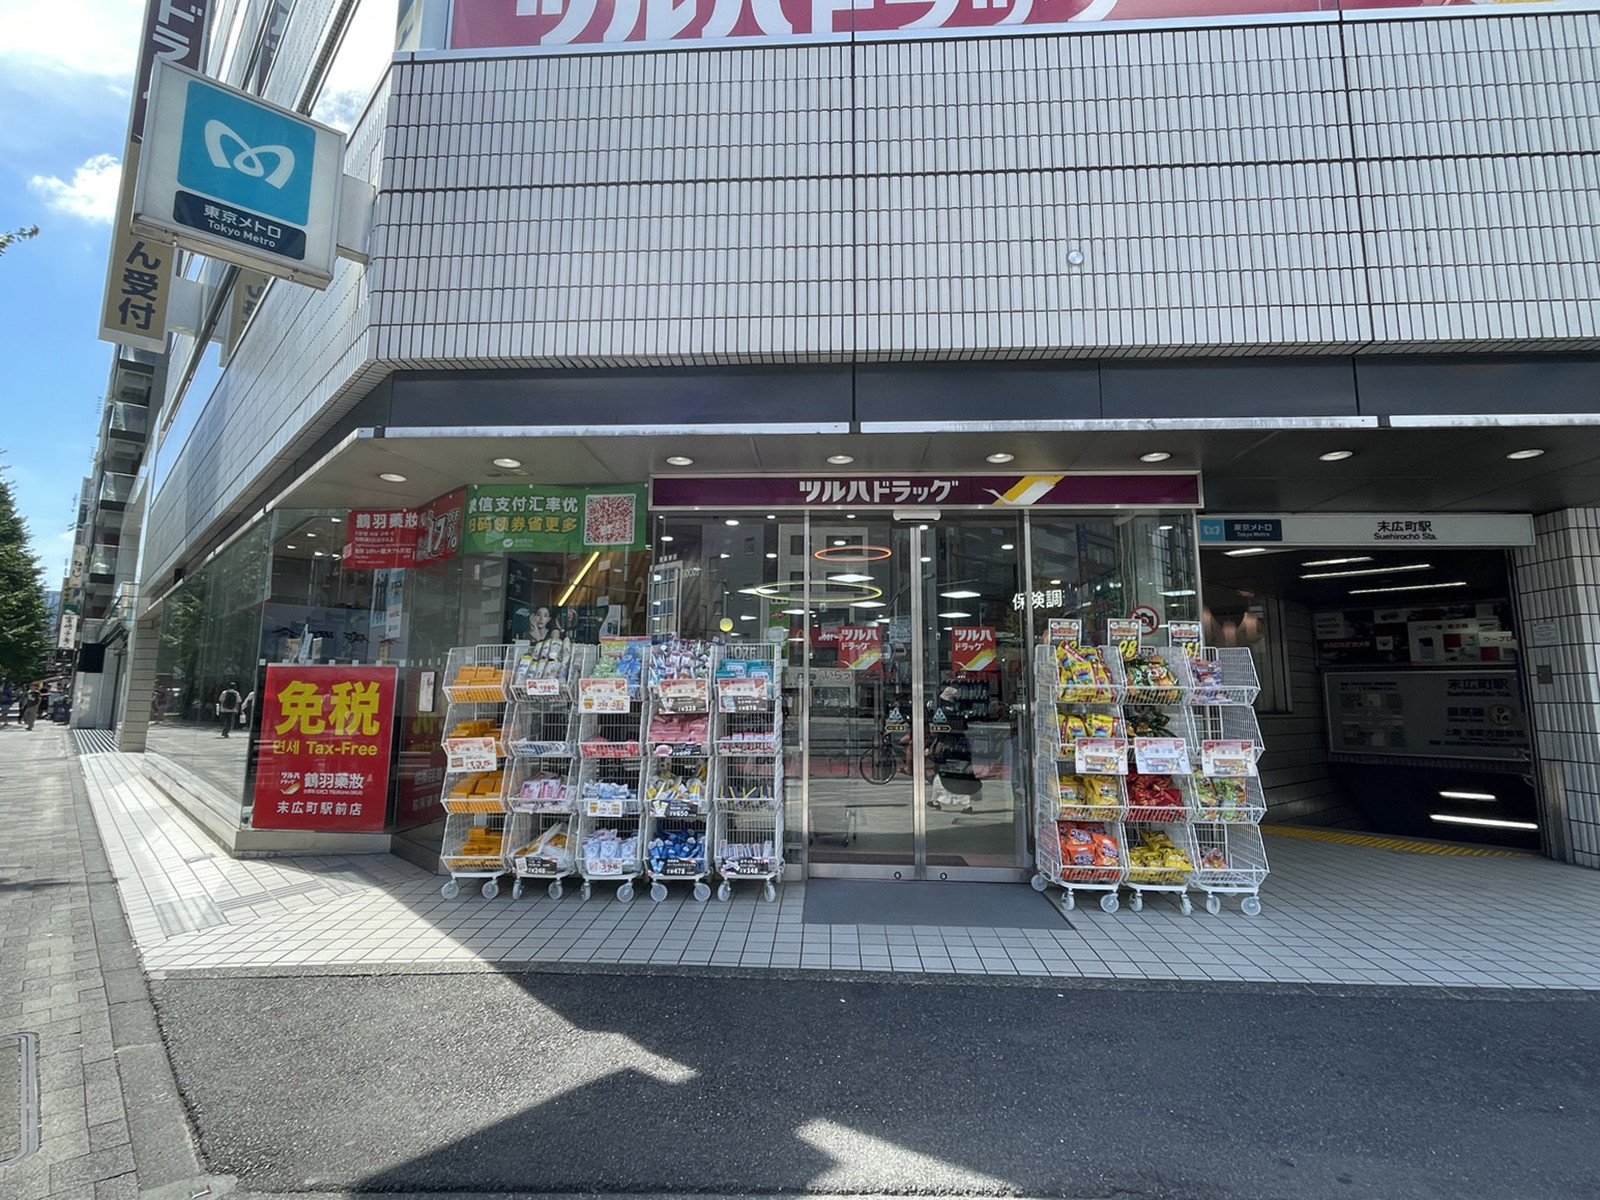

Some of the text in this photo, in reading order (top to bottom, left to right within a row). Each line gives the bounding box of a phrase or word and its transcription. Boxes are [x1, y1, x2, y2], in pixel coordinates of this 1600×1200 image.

[203, 203, 281, 239] 東京メトロ
[207, 219, 276, 248] Tokyo Metro
[119, 241, 161, 330] ん受付
[799, 479, 959, 503] ツルハドラッグ
[1233, 523, 1273, 532] 東京メトロ
[1377, 520, 1432, 532] 末広町駅
[1422, 532, 1438, 540] Sta.
[1012, 589, 1065, 611] 保険調
[841, 629, 878, 641] ツルハ
[954, 629, 993, 641] ツルハ
[841, 642, 870, 650] ドラッグ
[954, 642, 984, 650] ドラッグ
[1448, 678, 1510, 689] 末広町駅
[274, 680, 381, 736] 免税
[273, 741, 300, 755] 면세
[306, 740, 379, 756] Tax-Free
[277, 800, 362, 817] 末広町駅前店
